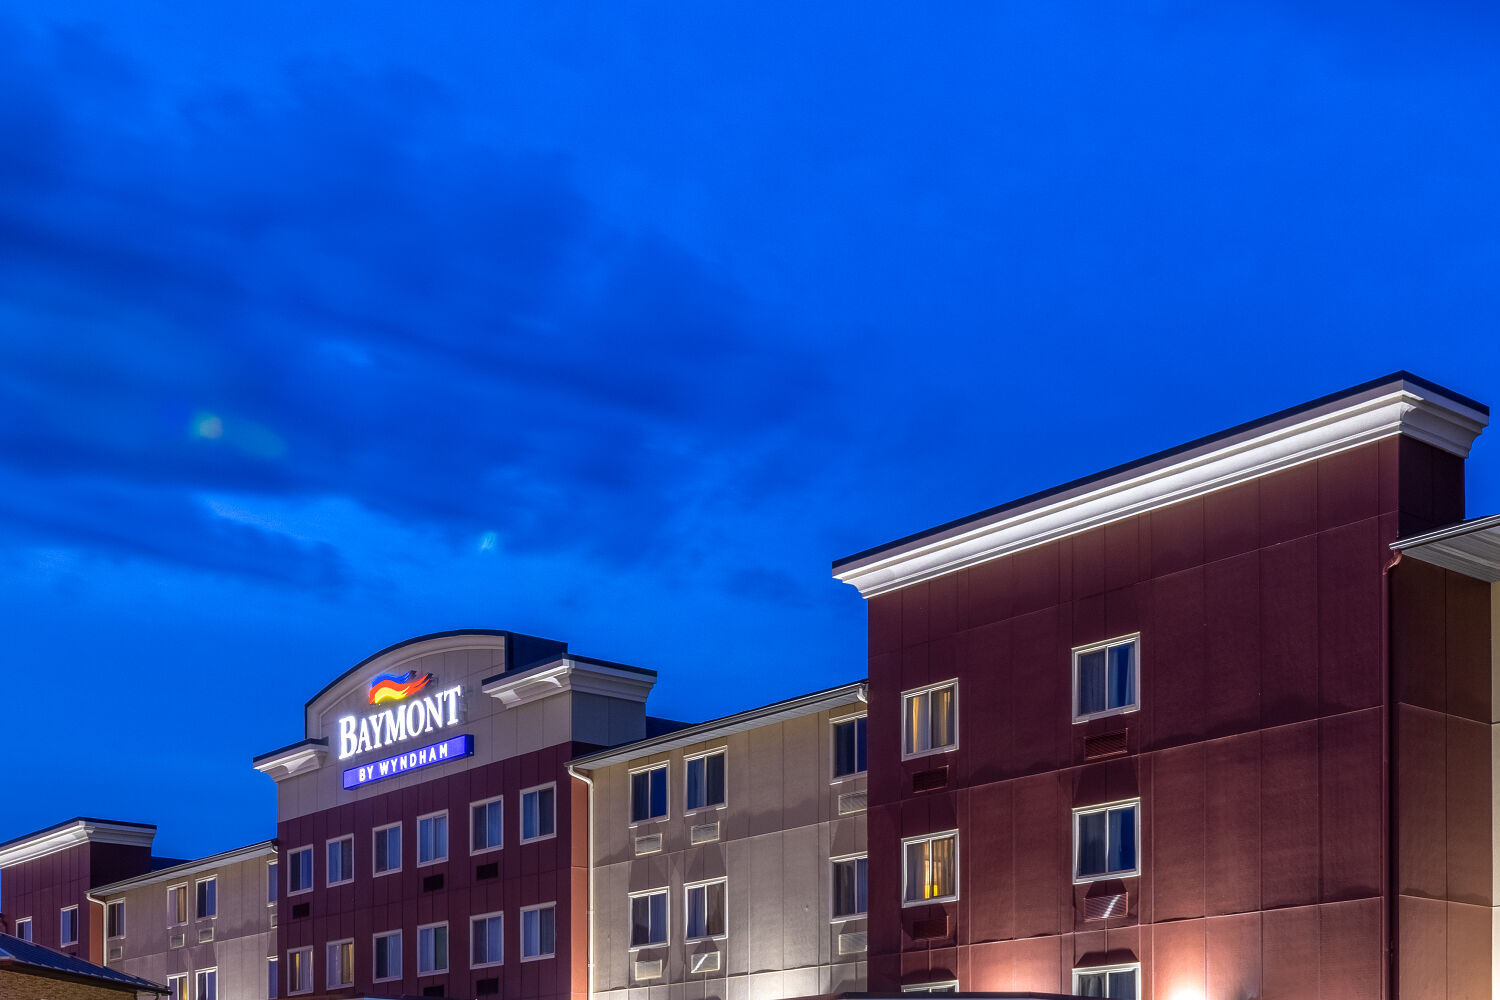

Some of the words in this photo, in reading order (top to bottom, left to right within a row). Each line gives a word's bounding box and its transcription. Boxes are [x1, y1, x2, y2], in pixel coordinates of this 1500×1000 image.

[338, 685, 461, 760] BAYMONT
[359, 766, 374, 782] BY
[380, 743, 448, 776] WYNDHAM
